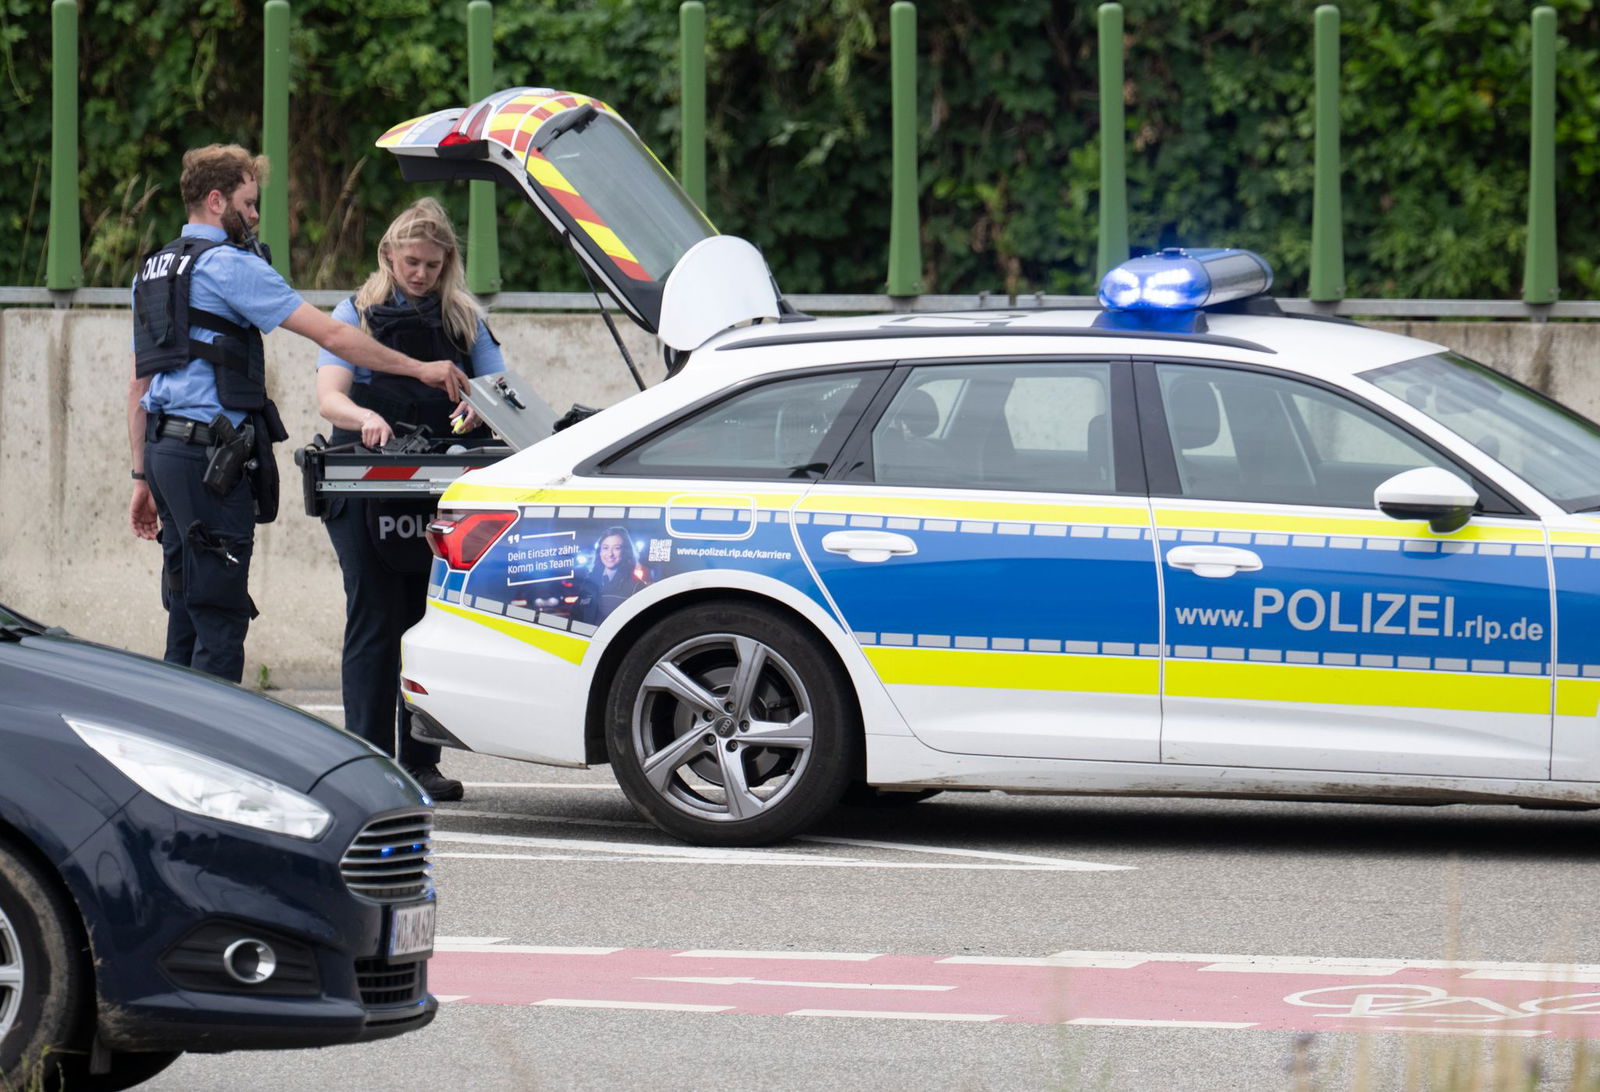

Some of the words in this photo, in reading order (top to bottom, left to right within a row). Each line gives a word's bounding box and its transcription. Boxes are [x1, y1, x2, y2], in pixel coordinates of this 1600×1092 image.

[142, 253, 191, 281] OLIZI
[507, 552, 526, 562] Dein
[527, 547, 557, 559] Einsatz
[558, 544, 582, 555] zählt.
[677, 547, 792, 560] www.polizei.rlp.de/karriere
[507, 563, 534, 574] Komm
[535, 560, 548, 570] ins
[549, 557, 575, 569] Team!
[1175, 587, 1544, 645] www.POLIZEI.rlp.de
